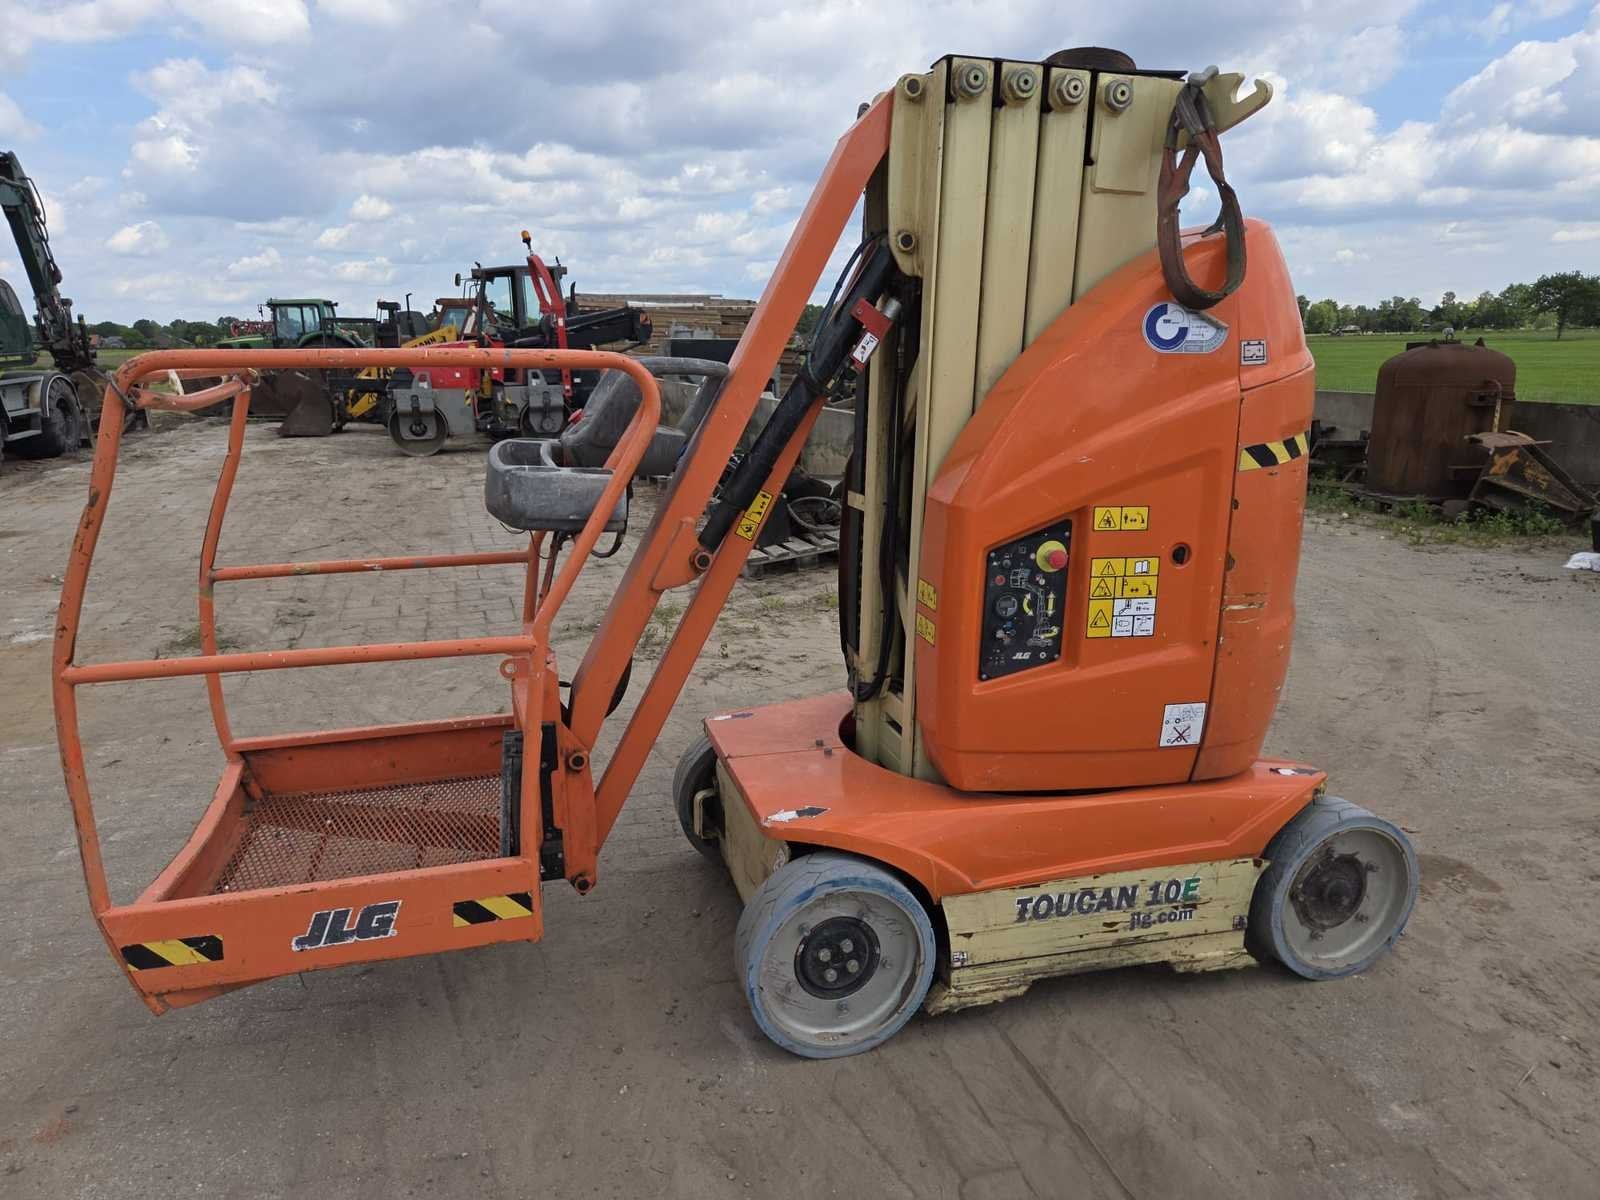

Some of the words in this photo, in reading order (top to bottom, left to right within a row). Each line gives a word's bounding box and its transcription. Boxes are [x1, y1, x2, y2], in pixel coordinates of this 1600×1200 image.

[1014, 884, 1139, 923] TOUCAN
[1145, 877, 1201, 907] 10E
[1128, 907, 1195, 931] jlg.com
[291, 900, 402, 951] JLG
